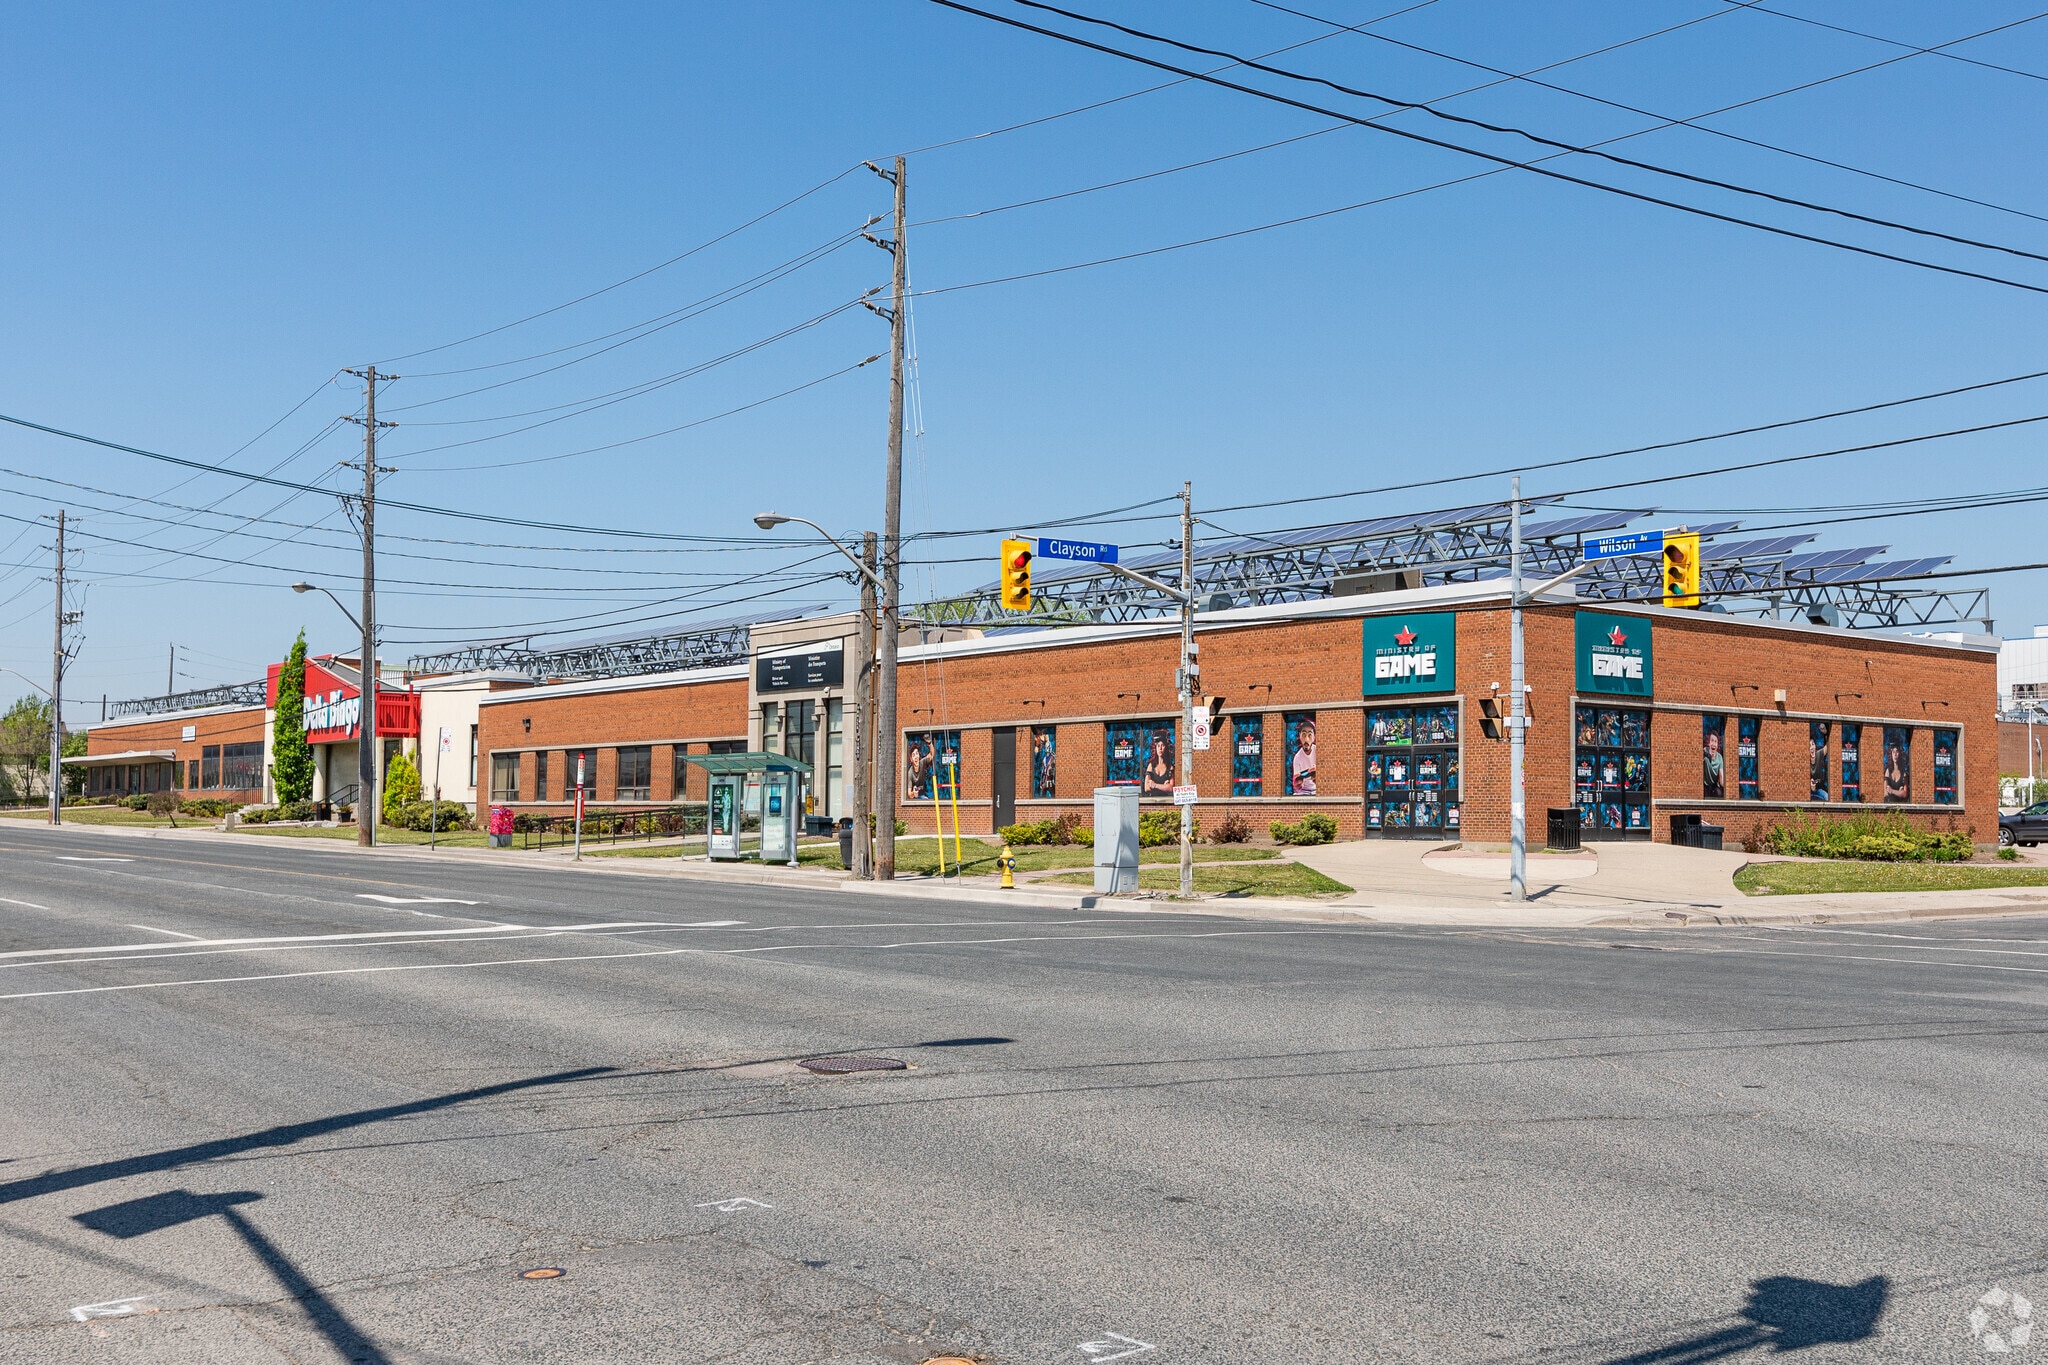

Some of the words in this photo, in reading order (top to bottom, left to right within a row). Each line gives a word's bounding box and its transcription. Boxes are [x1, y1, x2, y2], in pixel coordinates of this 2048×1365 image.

[1049, 540, 1096, 559] Clayson
[1100, 545, 1108, 553] Rd
[1599, 538, 1636, 554] Wilson
[1640, 534, 1648, 542] Av
[1376, 645, 1421, 655] MINISTRY
[1424, 644, 1436, 652] OF
[1375, 652, 1436, 679] GAME
[1592, 653, 1644, 679] GAME
[330, 689, 361, 736] Bingo
[1114, 750, 1134, 759] GAME
[1239, 745, 1260, 754] GAME
[1174, 785, 1195, 793] PSYCHIC
